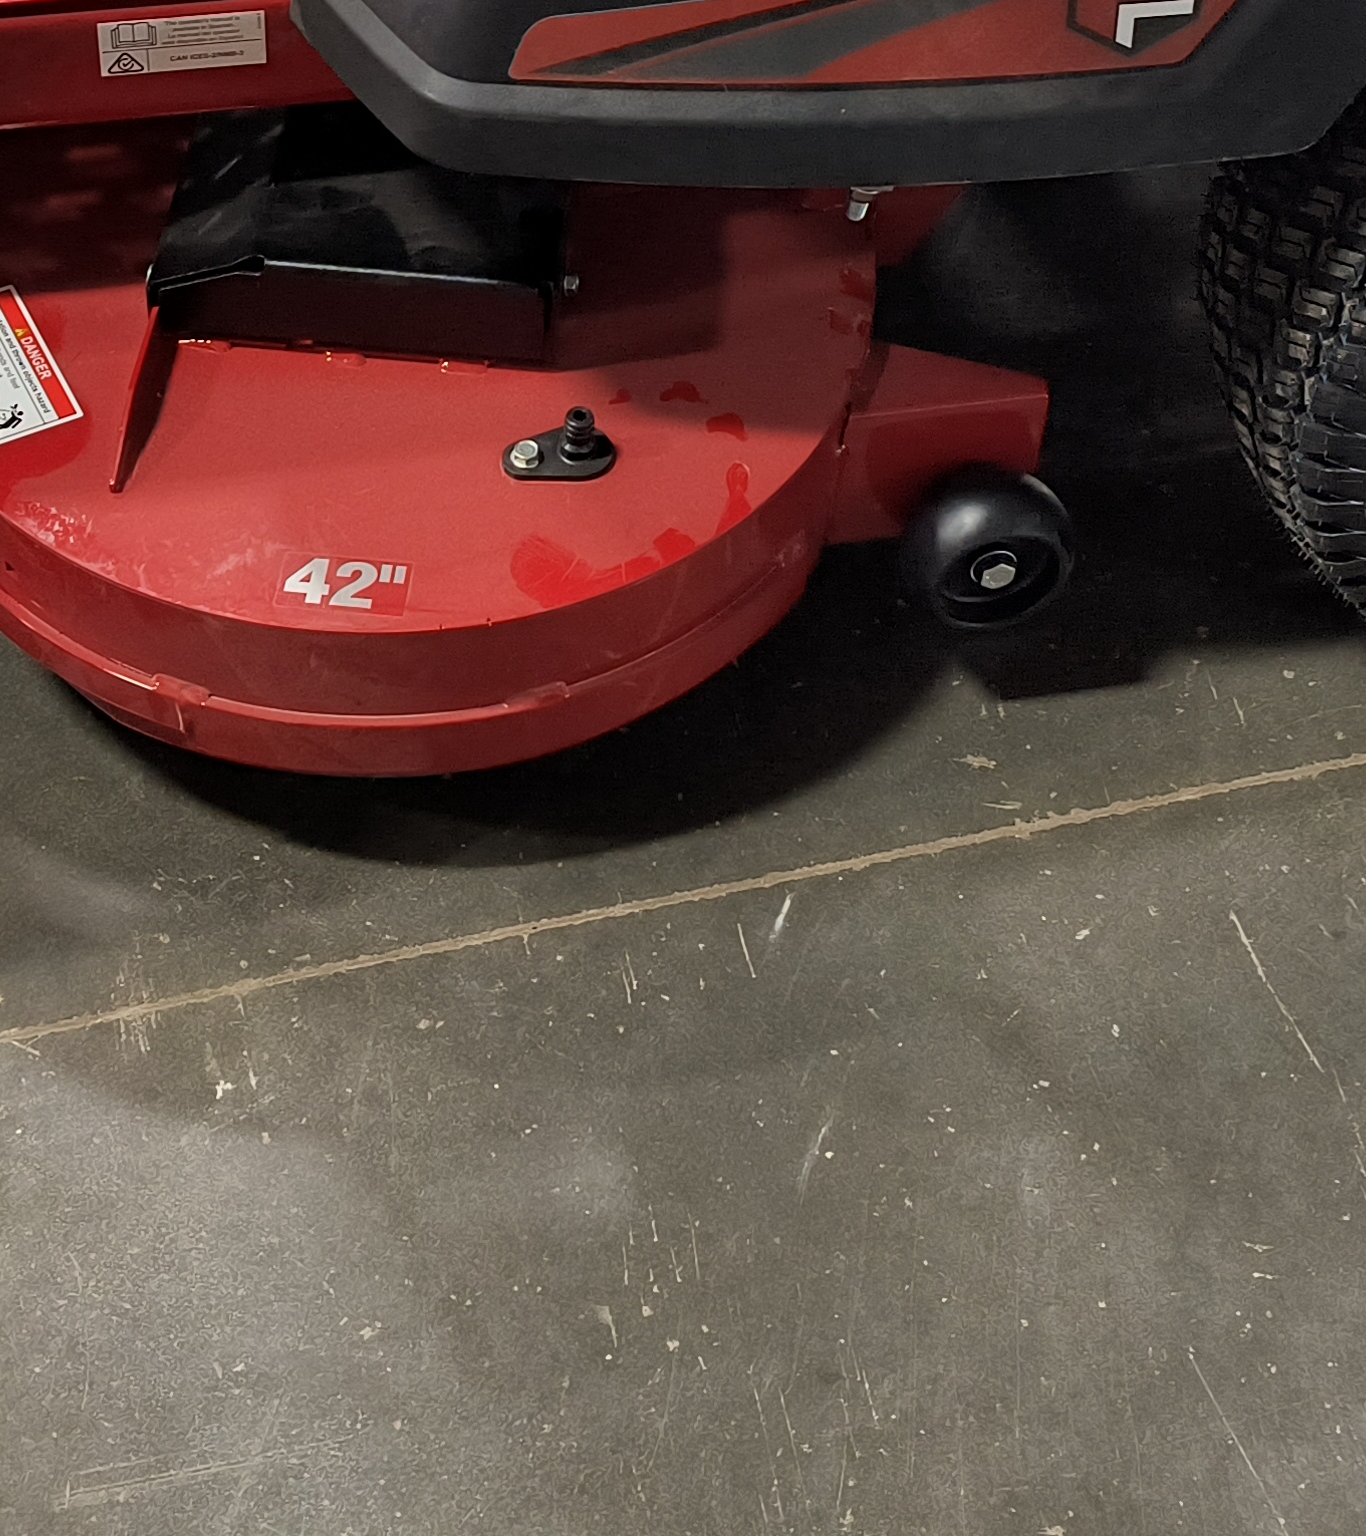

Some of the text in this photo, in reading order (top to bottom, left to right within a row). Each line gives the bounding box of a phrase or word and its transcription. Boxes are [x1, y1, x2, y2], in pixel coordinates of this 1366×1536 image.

[3, 366, 14, 377] and
[5, 337, 16, 348] and
[11, 348, 28, 370] thrown
[21, 370, 39, 392] objects
[34, 392, 51, 413] hazard
[19, 335, 52, 379] DANGER
[283, 558, 407, 609] 42"
